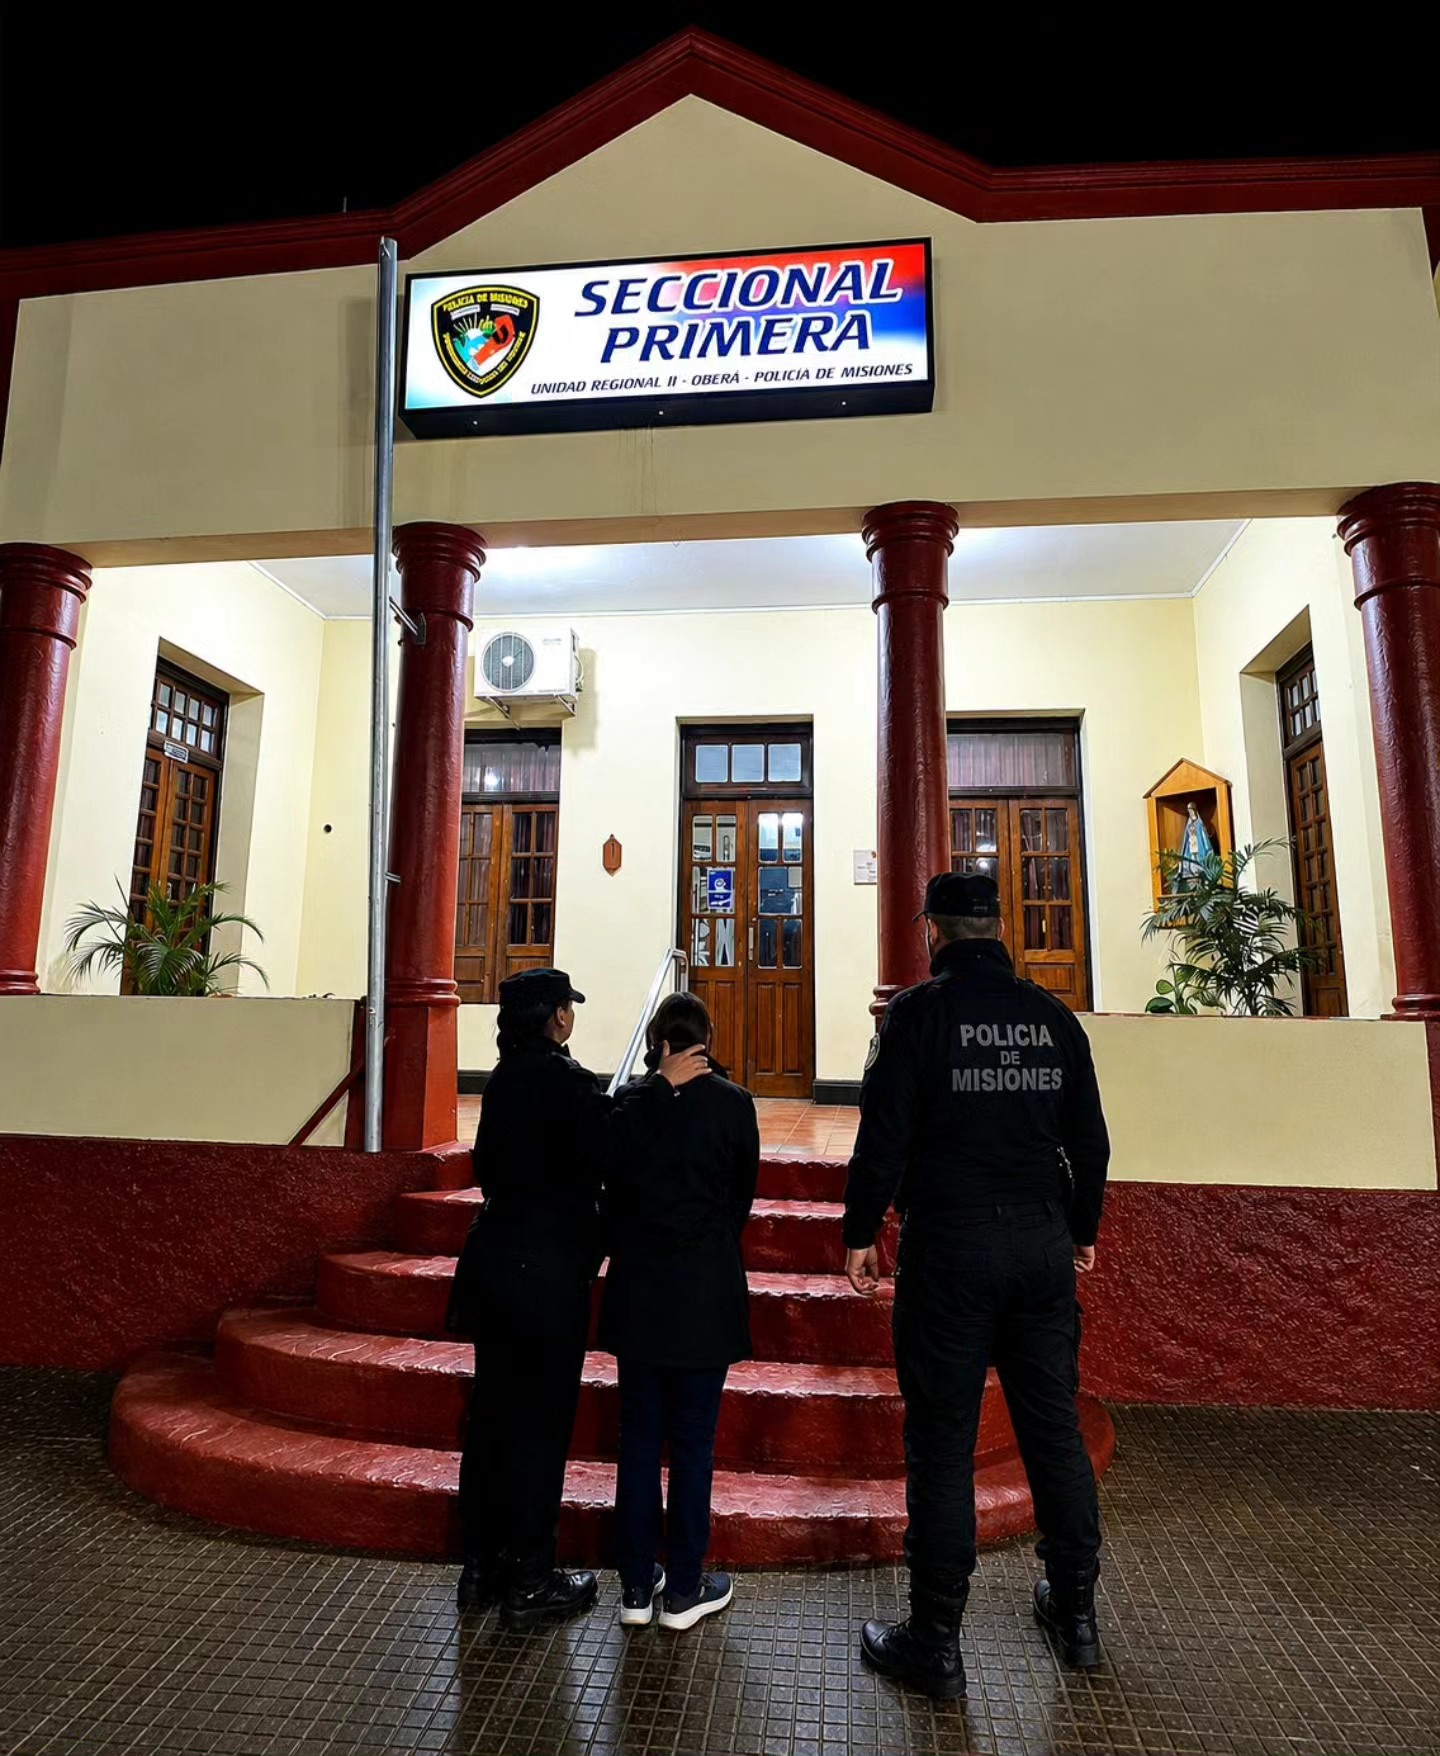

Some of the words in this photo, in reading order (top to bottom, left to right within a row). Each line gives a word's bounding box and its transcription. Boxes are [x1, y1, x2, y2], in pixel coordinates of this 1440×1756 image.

[574, 262, 899, 317] SECCIONAL
[600, 314, 870, 363] PRIMERA
[530, 380, 587, 395] UNIDAD
[590, 376, 661, 392] REGIONAL
[691, 370, 740, 387] OBERÁ
[815, 367, 835, 380] DE
[840, 363, 913, 379] MISIONES
[960, 1024, 1054, 1047] POLICIA
[1000, 1051, 1021, 1065] DE
[952, 1068, 1063, 1091] MISIONES
